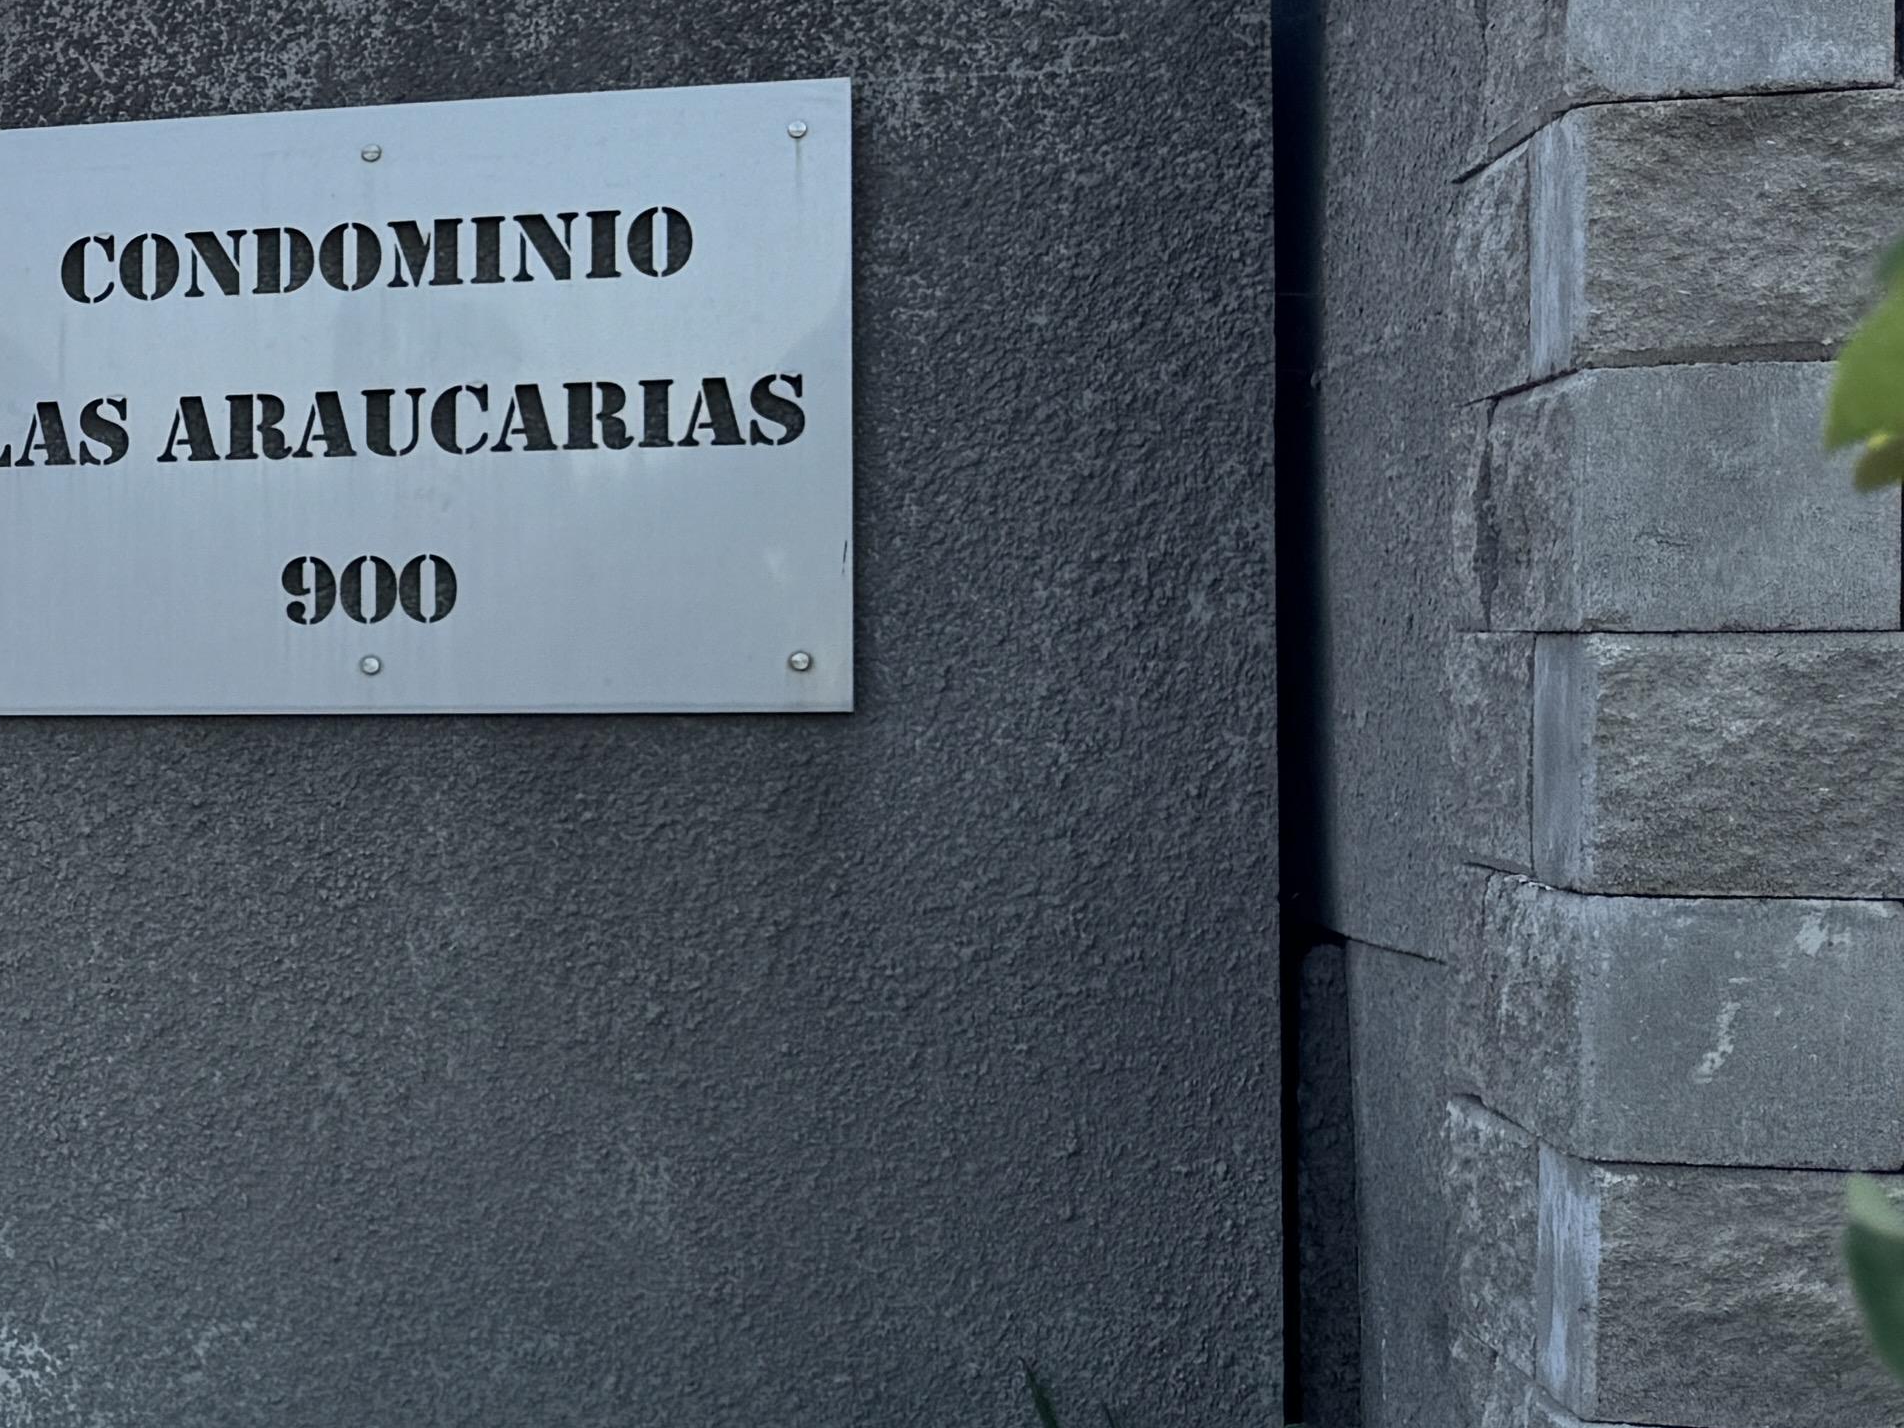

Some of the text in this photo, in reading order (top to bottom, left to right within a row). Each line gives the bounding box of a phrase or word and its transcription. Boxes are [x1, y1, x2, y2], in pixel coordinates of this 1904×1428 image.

[59, 205, 694, 305] CONDOMINIO
[156, 372, 807, 464] ARAUCARIAS
[280, 553, 458, 626] 900
